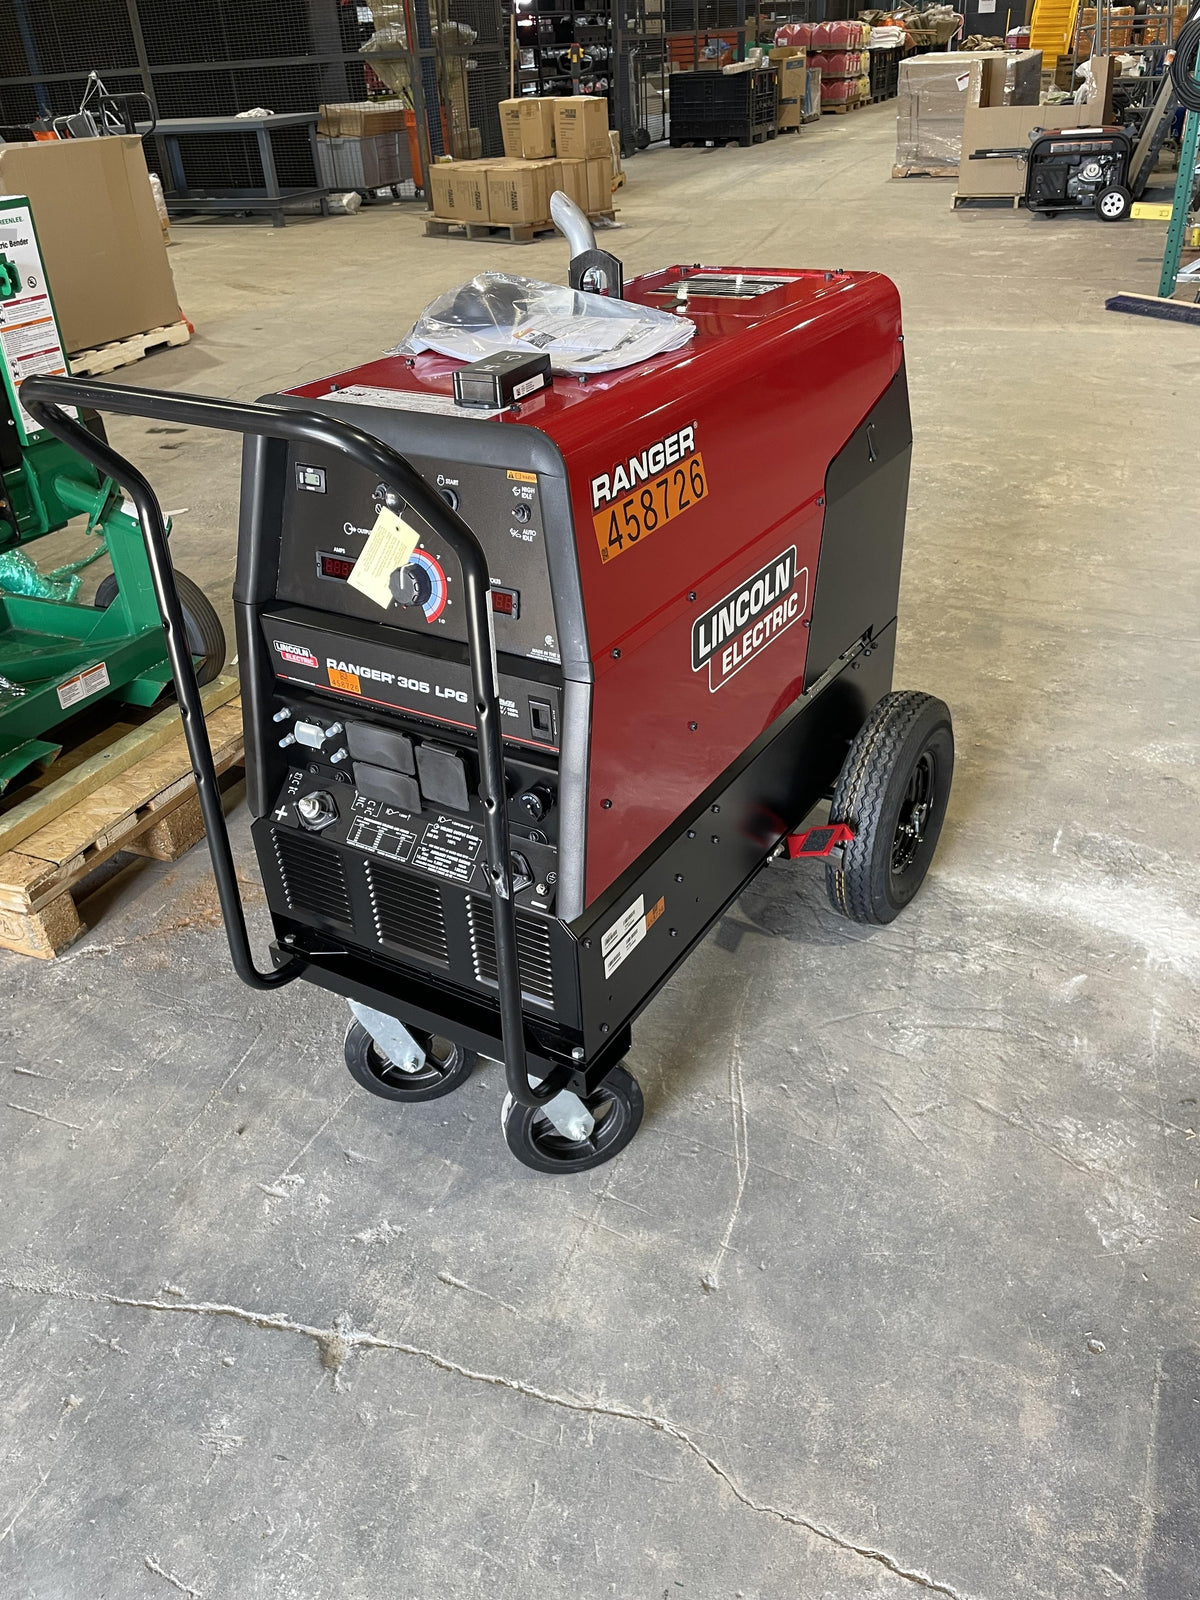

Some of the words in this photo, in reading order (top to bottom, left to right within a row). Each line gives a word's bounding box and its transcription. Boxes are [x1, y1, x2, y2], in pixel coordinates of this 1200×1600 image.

[9, 238, 29, 247] Bender
[608, 459, 704, 550] 458726
[699, 557, 791, 660] LINCOLN
[722, 593, 798, 675] ELECTRIC
[276, 642, 310, 657] LINCOLN
[285, 653, 315, 666] ELECTRIC
[397, 676, 430, 693] 305
[435, 685, 468, 703] LPG
